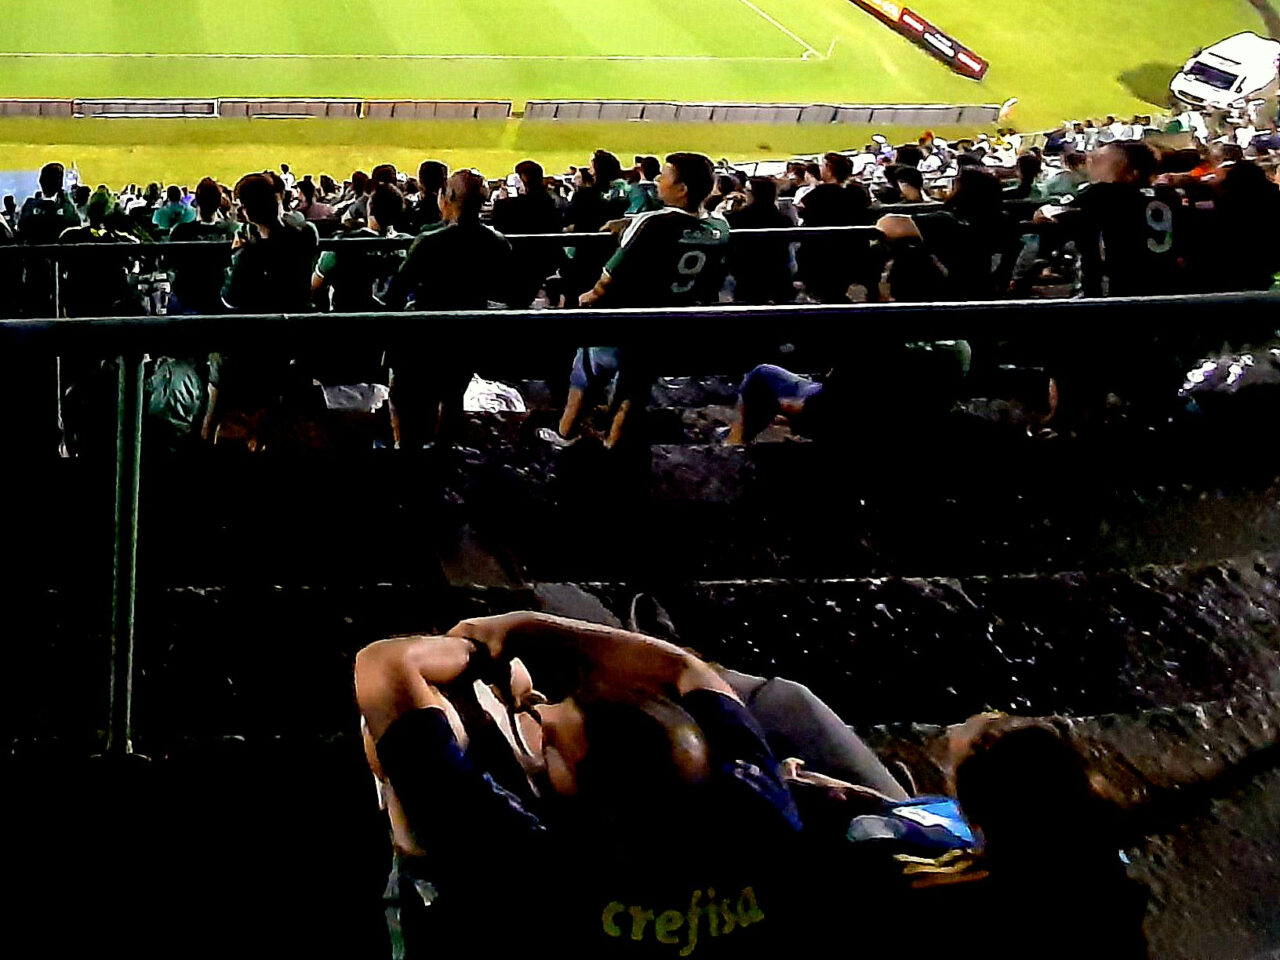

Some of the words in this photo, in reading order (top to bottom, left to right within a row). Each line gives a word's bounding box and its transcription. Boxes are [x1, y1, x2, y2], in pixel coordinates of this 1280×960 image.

[1145, 200, 1172, 253] 9
[670, 250, 706, 293] 9
[601, 886, 765, 957] crefisa
